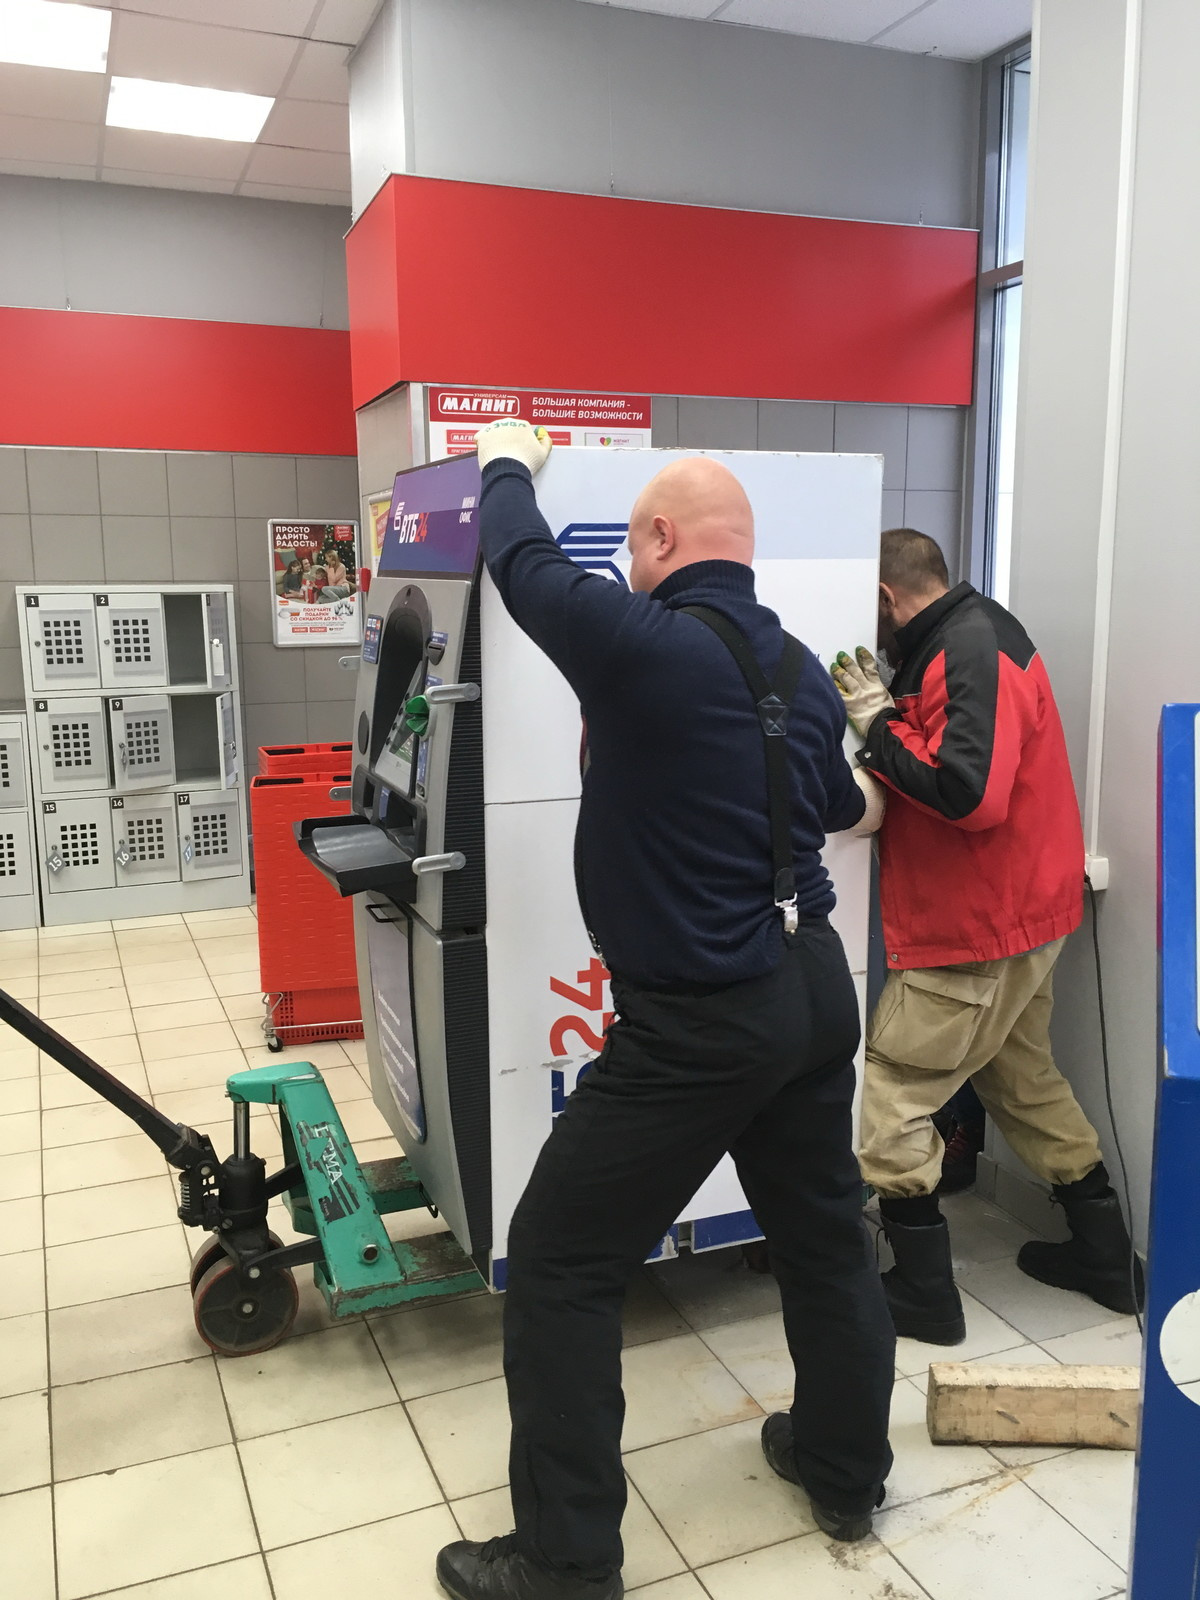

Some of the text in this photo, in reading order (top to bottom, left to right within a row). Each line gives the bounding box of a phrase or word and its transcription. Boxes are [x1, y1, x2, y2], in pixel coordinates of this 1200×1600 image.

[442, 397, 516, 412] МАГНИТ
[532, 397, 576, 407] БОЛЬШАЯ
[577, 398, 626, 408] КОМПАНИЯ
[532, 409, 643, 421] БОЛЬШИЕ ВОЗМОЖНОСТИ
[398, 512, 430, 544] ВТБ24
[113, 799, 123, 807] 16
[178, 795, 189, 803] 17
[45, 804, 55, 812] 15
[117, 851, 130, 866] 16
[184, 846, 193, 860] 17
[48, 857, 63, 872] 15
